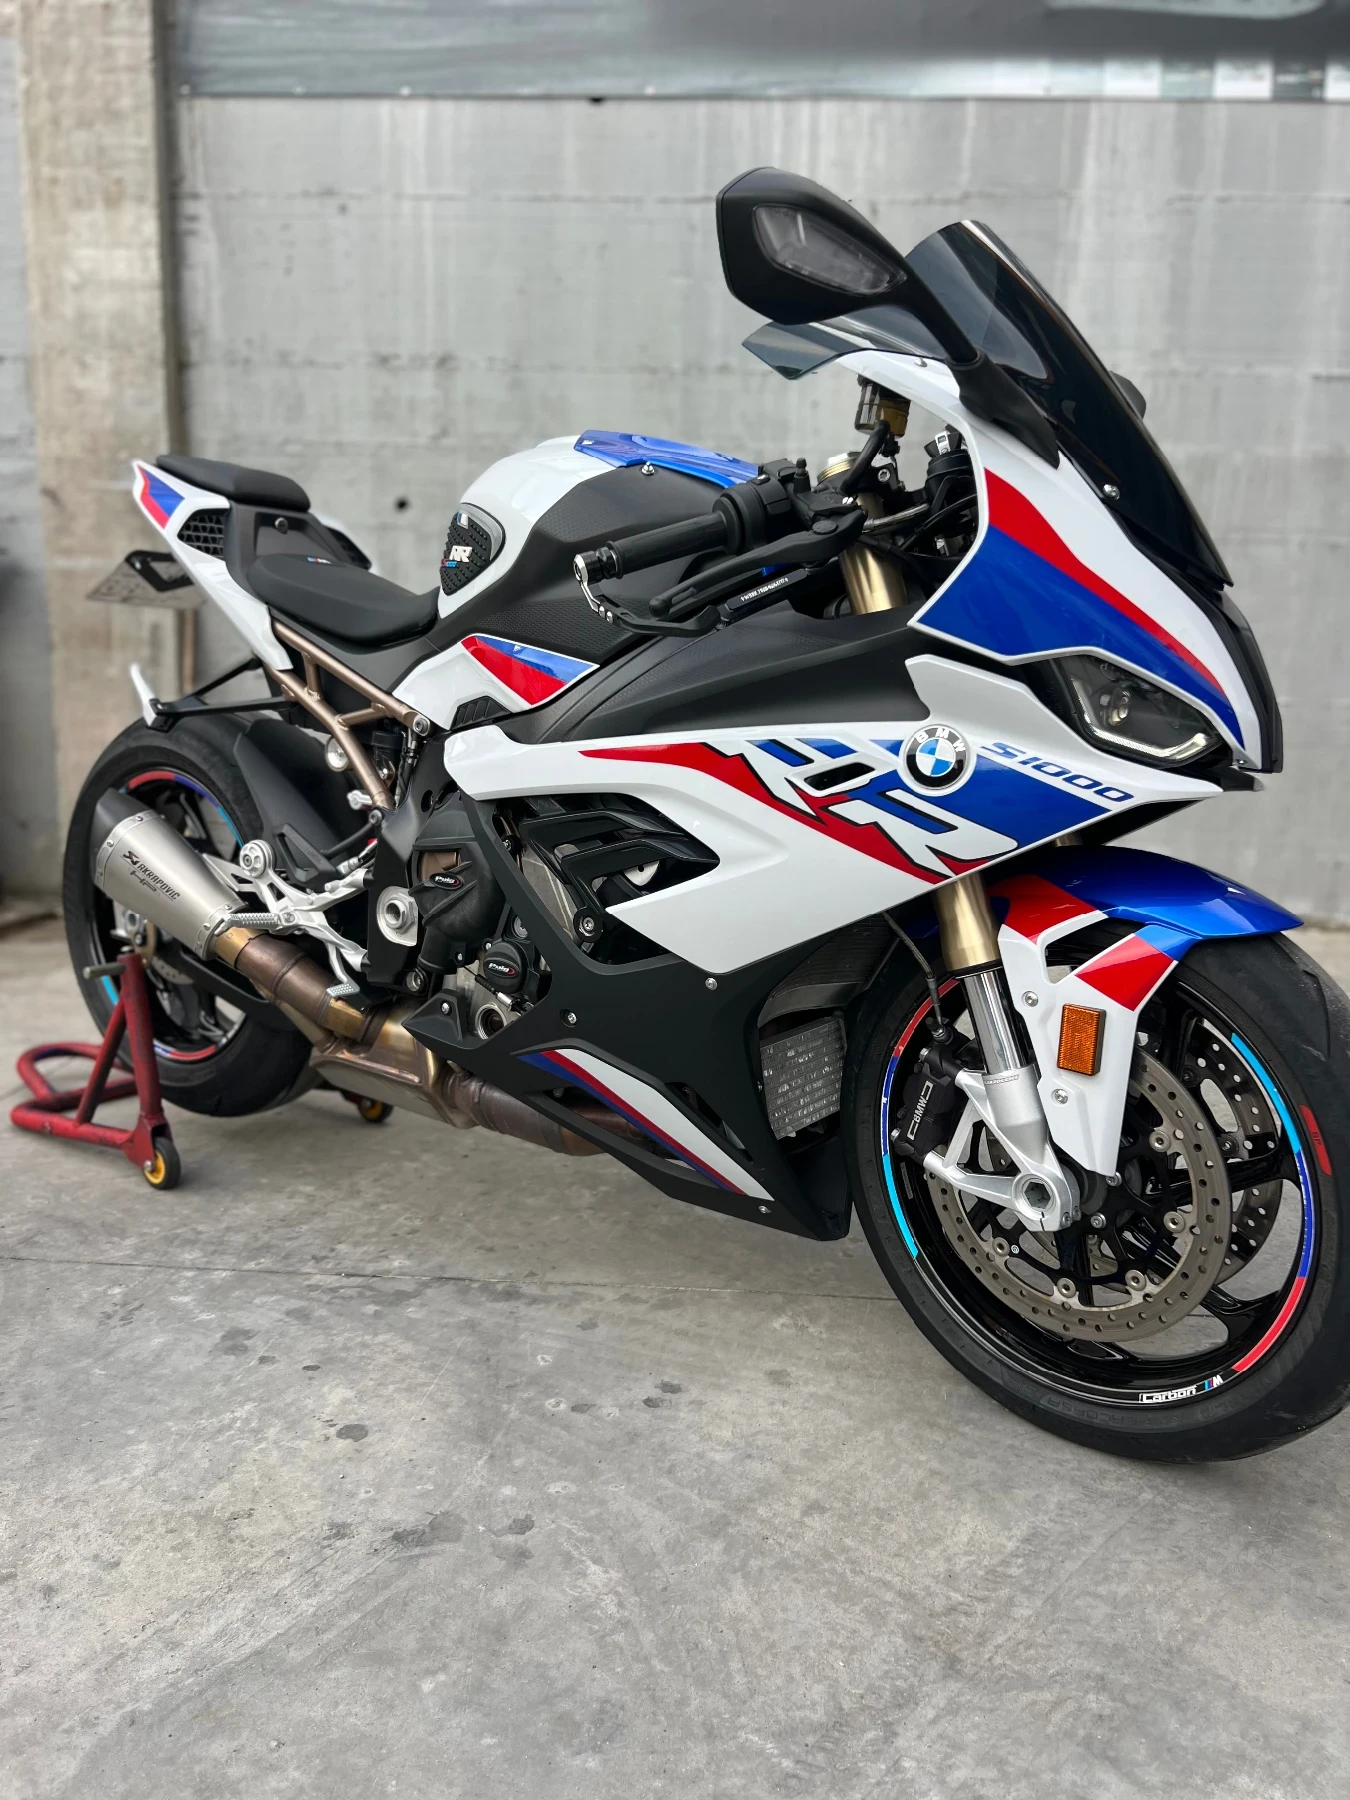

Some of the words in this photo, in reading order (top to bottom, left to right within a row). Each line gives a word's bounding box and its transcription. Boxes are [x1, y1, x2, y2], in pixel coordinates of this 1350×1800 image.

[914, 727, 966, 753] BMW
[980, 741, 1135, 803] S1000
[434, 875, 457, 885] Puig
[488, 962, 511, 973] Puig
[913, 1097, 929, 1124] BMW
